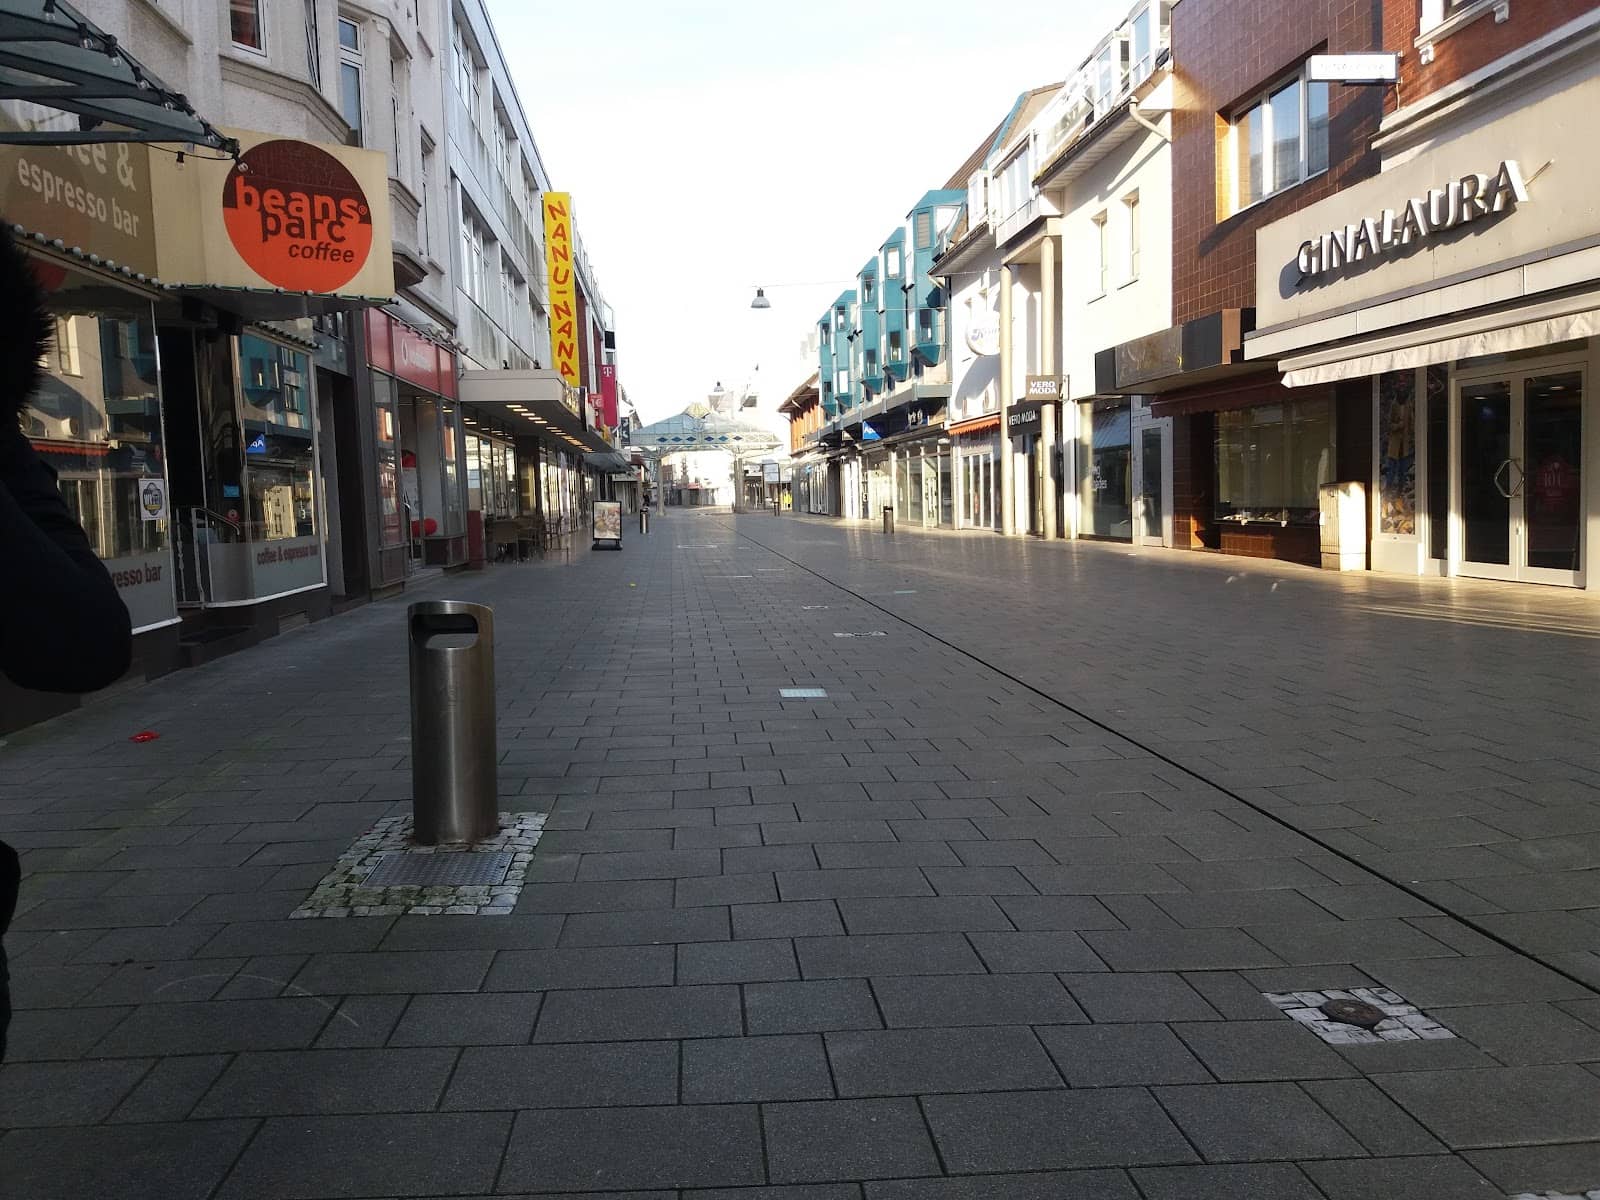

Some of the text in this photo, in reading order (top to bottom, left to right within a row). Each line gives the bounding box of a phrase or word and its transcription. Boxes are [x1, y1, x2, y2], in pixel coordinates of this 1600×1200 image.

[18, 157, 107, 223] espresso
[112, 197, 140, 238] bar
[262, 213, 347, 243] parc
[1296, 159, 1530, 276] GINALAURA
[288, 241, 355, 263] coffee
[548, 200, 576, 378] NANU-NANA
[1029, 387, 1057, 395] MODA
[1030, 380, 1056, 388] VERO
[1008, 410, 1037, 427] VERO MODA
[112, 562, 162, 589] resso bar
